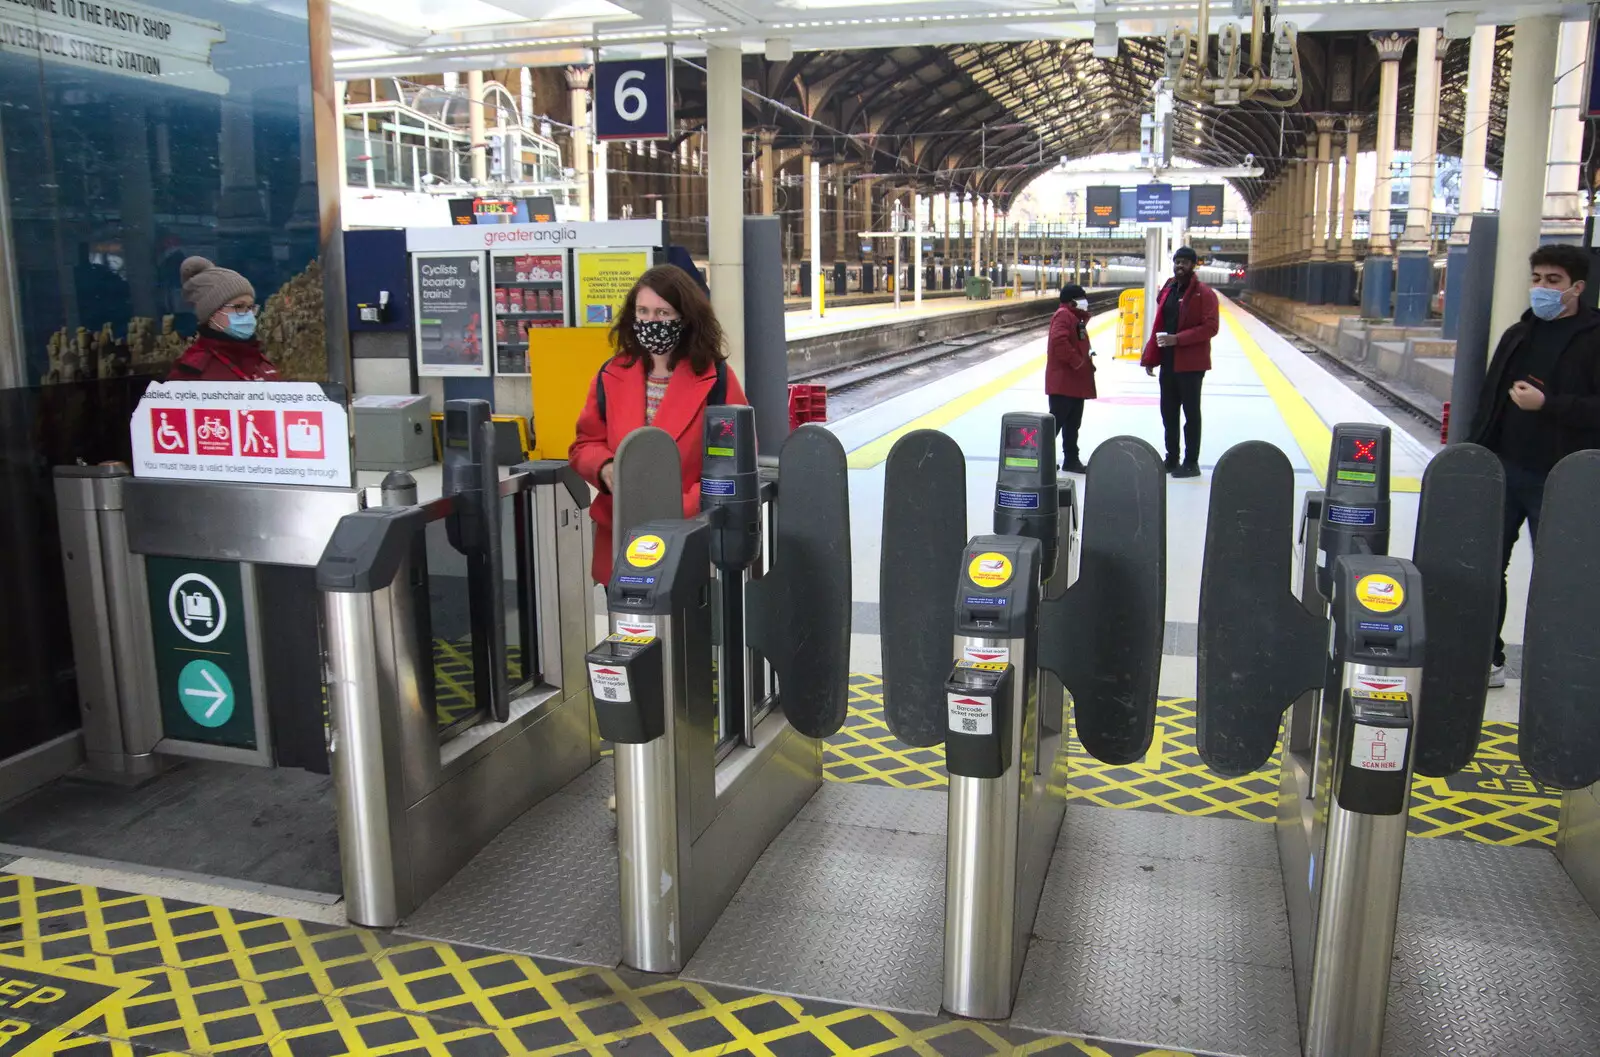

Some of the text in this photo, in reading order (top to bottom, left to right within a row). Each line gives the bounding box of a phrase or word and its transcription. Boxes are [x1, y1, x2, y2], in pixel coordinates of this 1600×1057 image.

[61, 0, 76, 18] TO
[78, 1, 102, 25] THE
[104, 7, 140, 34] PASTY
[143, 18, 171, 41] SHOP
[70, 39, 113, 66] STREET
[116, 50, 160, 75] STATION
[614, 70, 648, 121] 6
[484, 227, 577, 246] greateranglia
[421, 264, 458, 276] Cyclists
[422, 277, 466, 289] boarding
[175, 391, 199, 402] cycle,
[202, 391, 245, 403] pushchair
[247, 391, 265, 401] and
[267, 392, 303, 403] luggage
[143, 460, 158, 470] You
[159, 461, 178, 471] must
[179, 462, 197, 472] have
[207, 463, 223, 472] valid
[225, 464, 246, 473] ticket
[247, 464, 273, 474] before
[275, 466, 305, 478] passing
[307, 467, 339, 479] through
[1393, 624, 1403, 632] 82
[597, 674, 620, 683] Barcode
[956, 704, 982, 714] Barcode
[968, 711, 989, 719] reader
[1362, 760, 1397, 769] SCAN HERE
